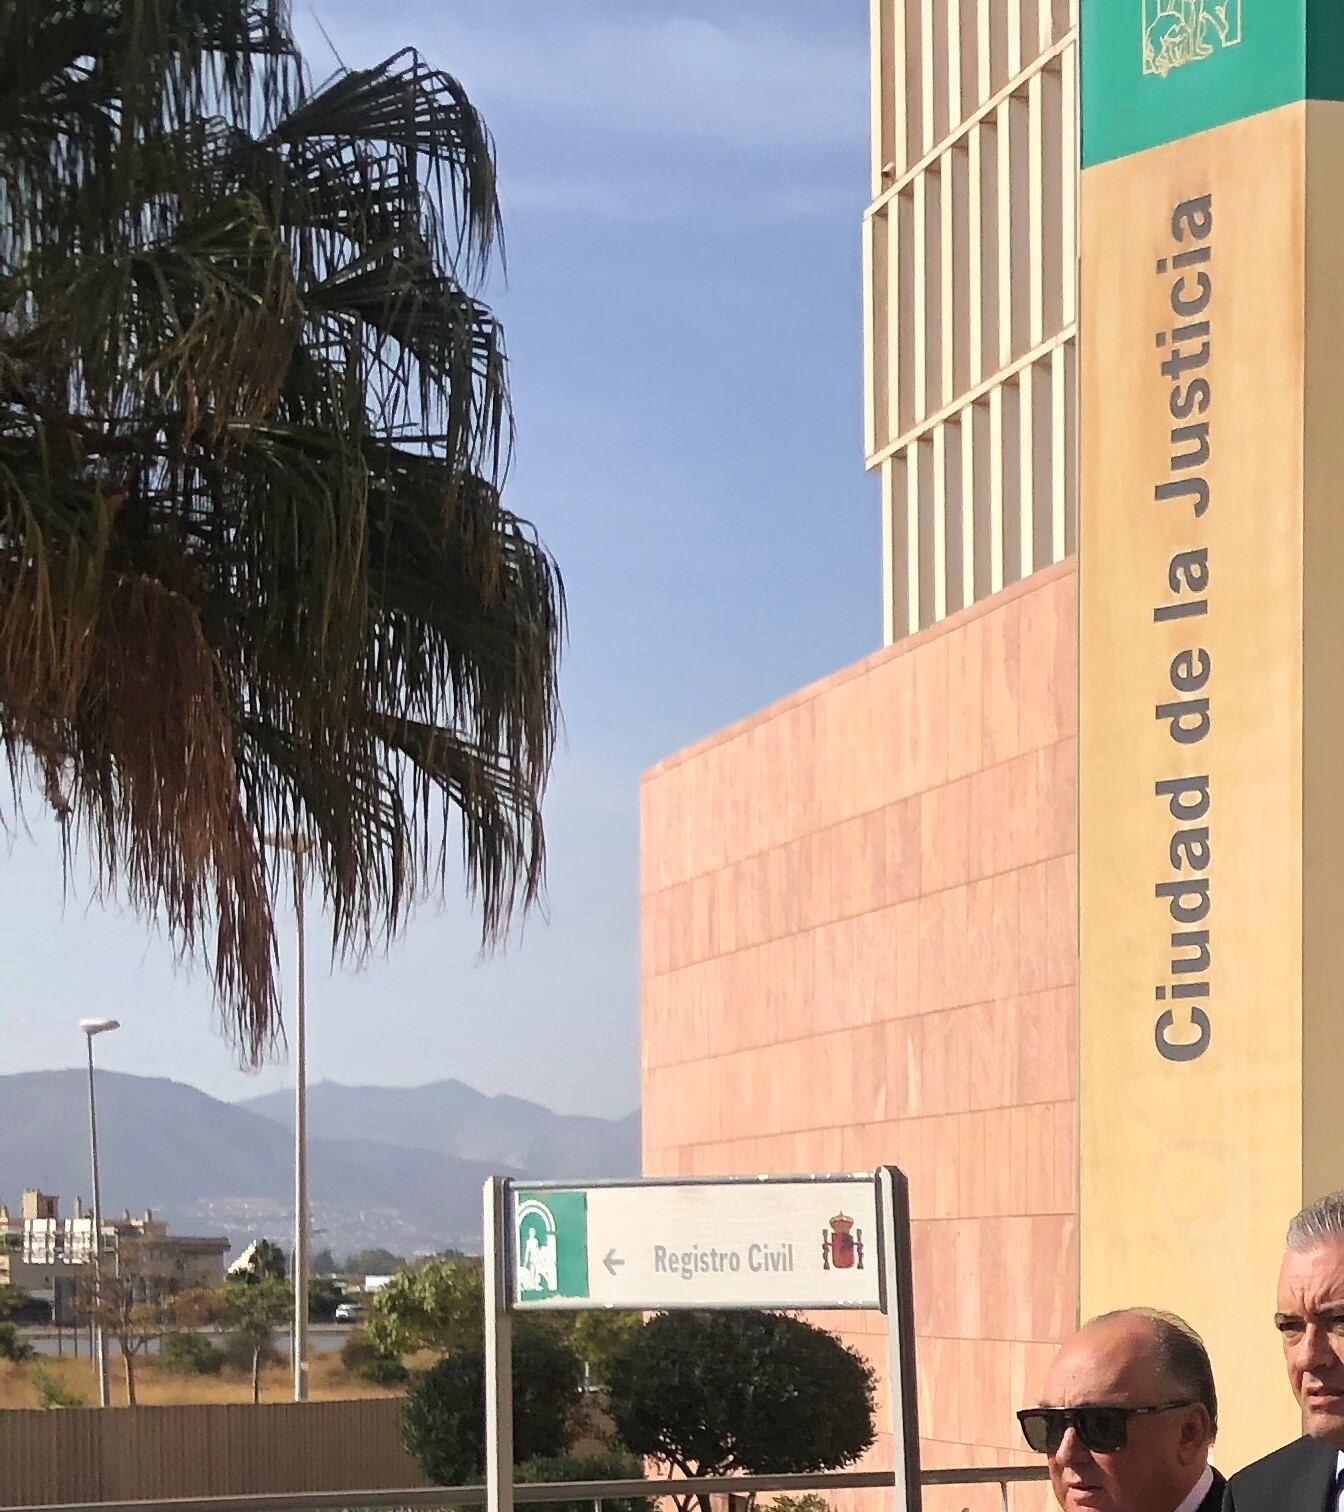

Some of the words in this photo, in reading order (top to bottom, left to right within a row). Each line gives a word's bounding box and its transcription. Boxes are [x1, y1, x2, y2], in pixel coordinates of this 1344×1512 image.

[1154, 193, 1212, 518] Justicia
[1153, 547, 1209, 623] la
[1155, 647, 1211, 744] de
[1154, 775, 1211, 1062] Ciudad
[654, 1245, 741, 1281] Registro
[748, 1243, 794, 1273] Civil
